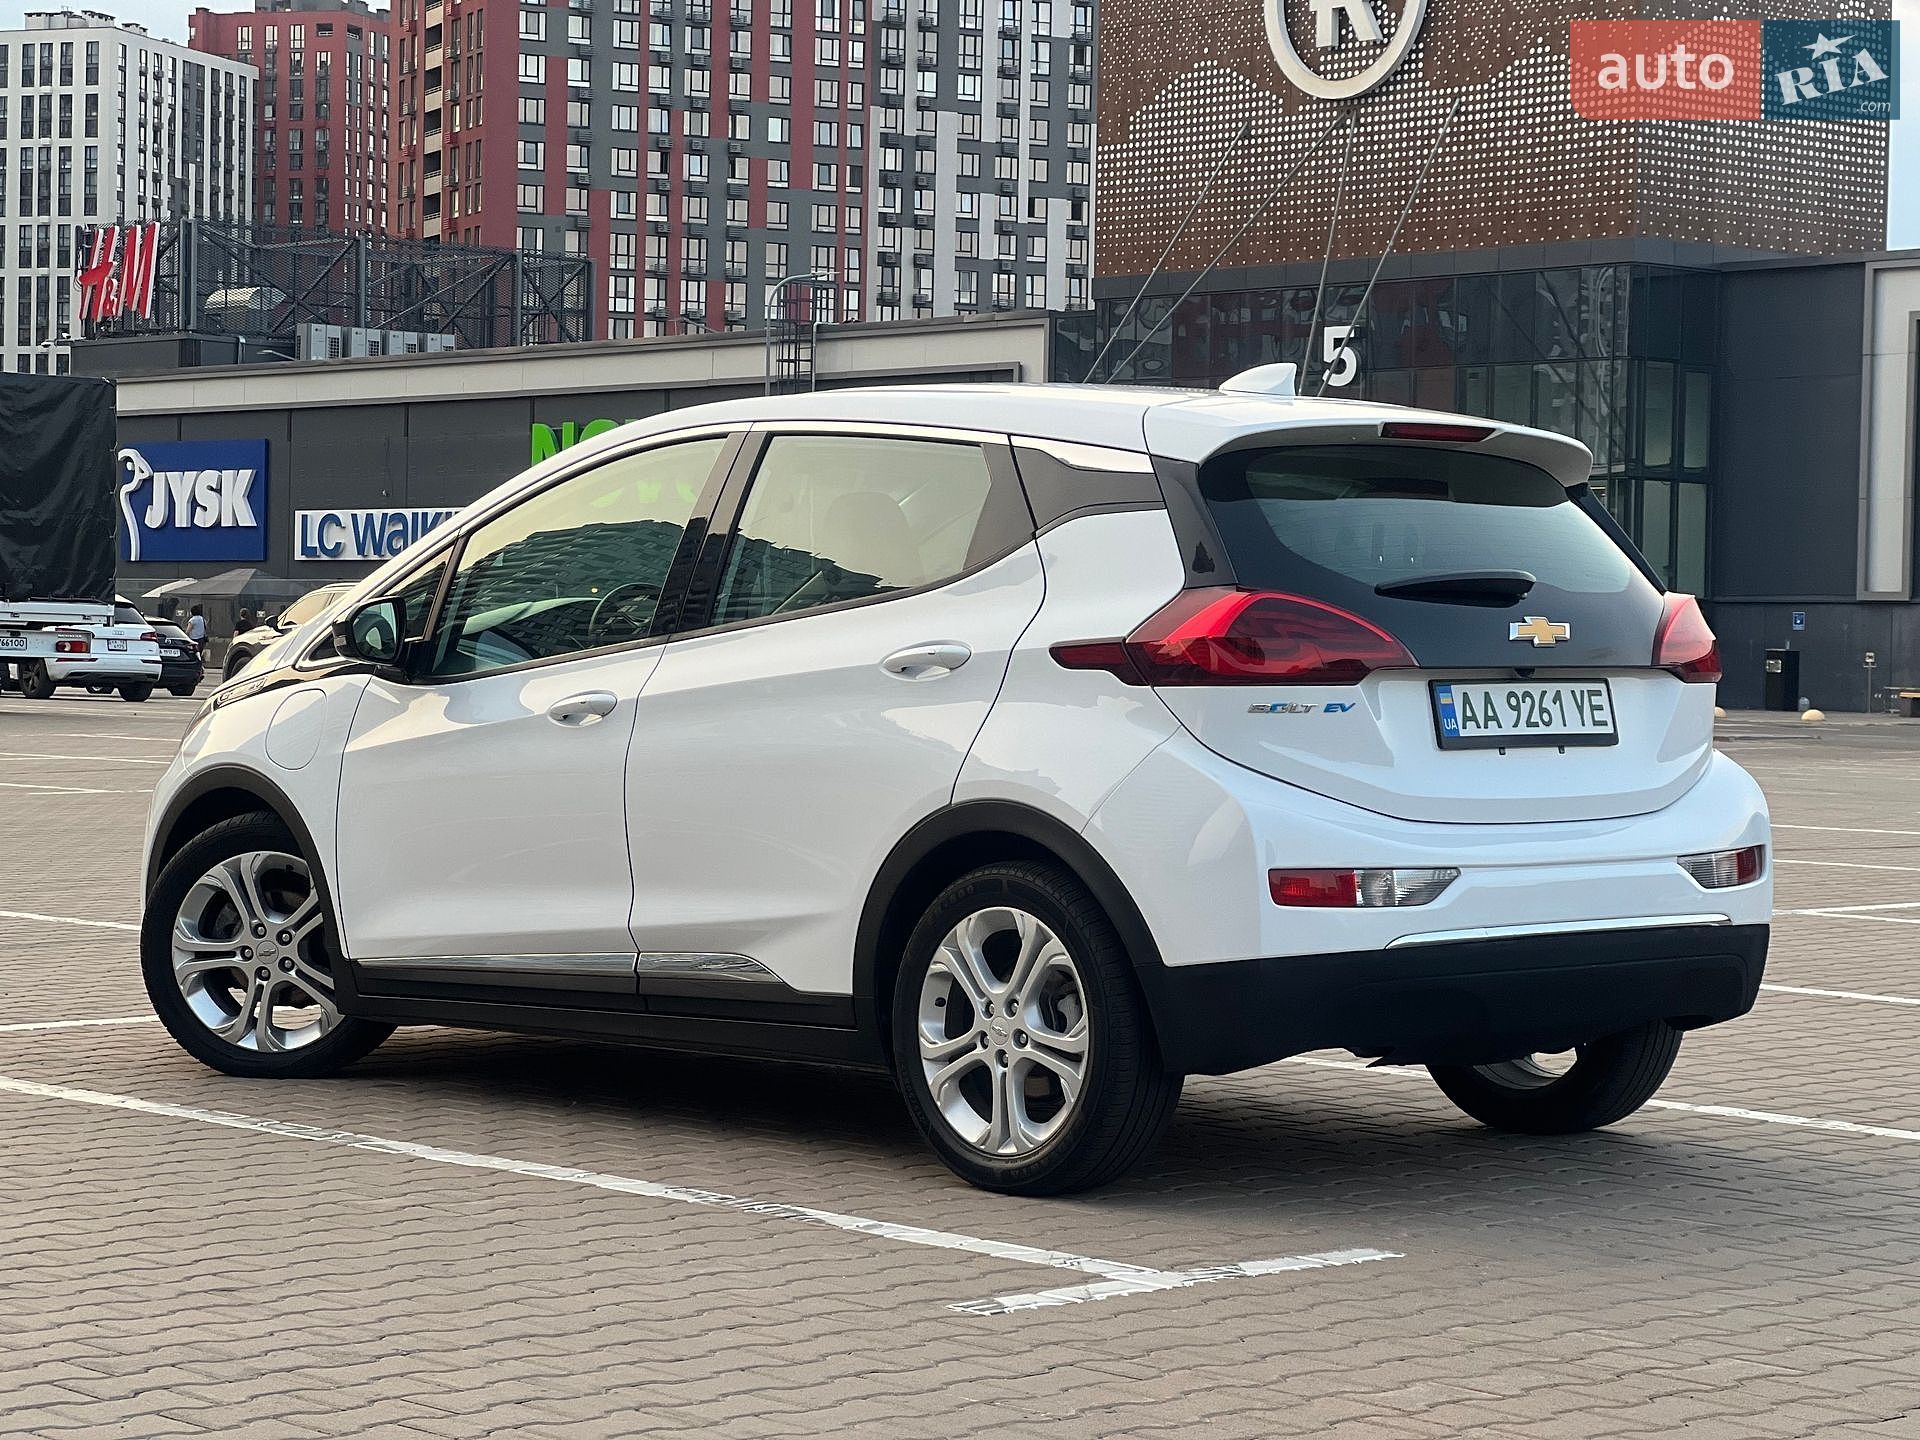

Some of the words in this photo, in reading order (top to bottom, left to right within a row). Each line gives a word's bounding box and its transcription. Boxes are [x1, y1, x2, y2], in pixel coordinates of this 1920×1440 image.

[78, 221, 160, 322] H&M
[1322, 325, 1357, 387] 5
[144, 469, 258, 529] JYSK
[300, 513, 346, 558] LC
[1323, 702, 1356, 713] EV
[1443, 718, 1459, 730] UA
[1461, 691, 1503, 730] AA
[1506, 690, 1567, 729] 9261
[1570, 689, 1608, 727] YE
